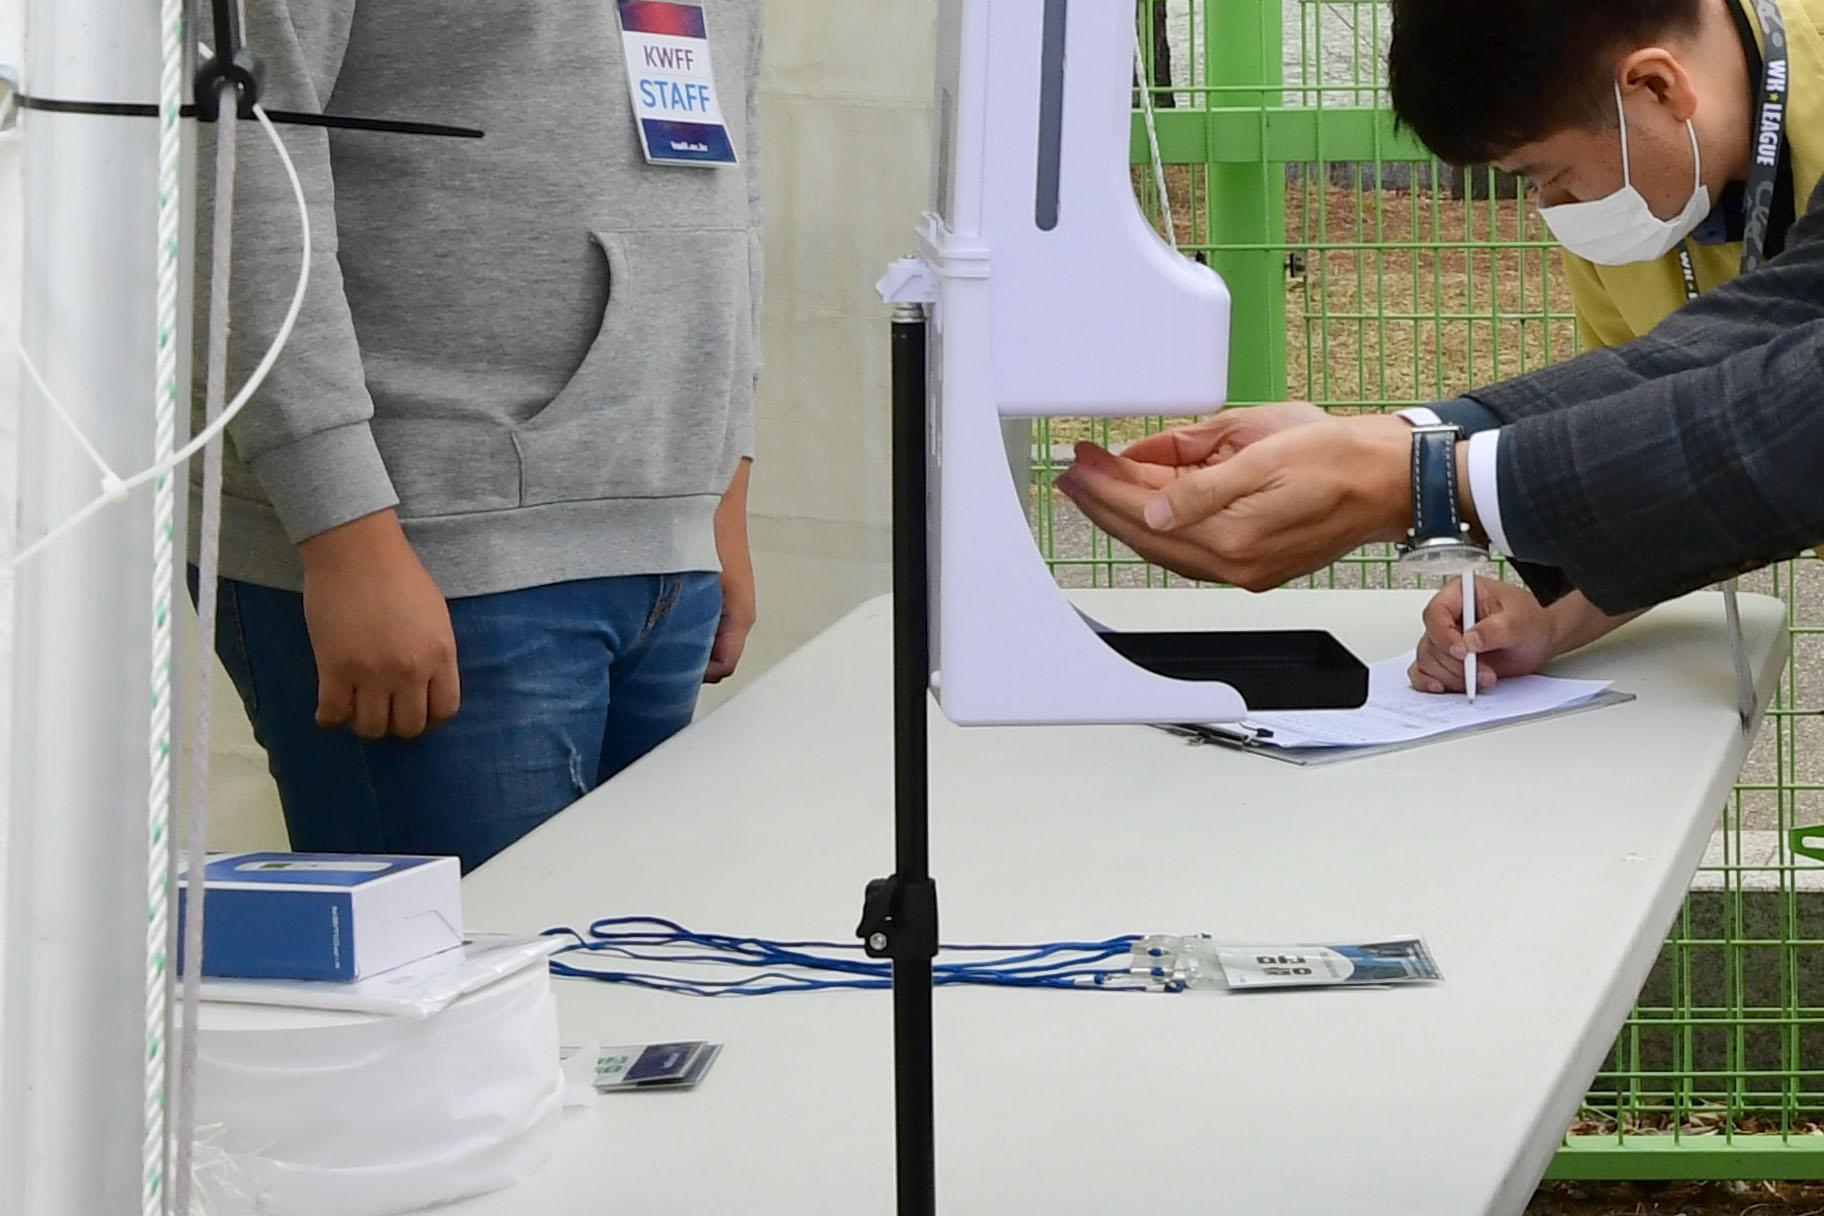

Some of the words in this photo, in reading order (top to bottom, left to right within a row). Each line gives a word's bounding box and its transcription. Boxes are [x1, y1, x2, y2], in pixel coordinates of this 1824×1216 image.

[643, 44, 695, 72] KWFF
[639, 78, 711, 113] STAFF
[1756, 103, 1783, 168] LEAGUE
